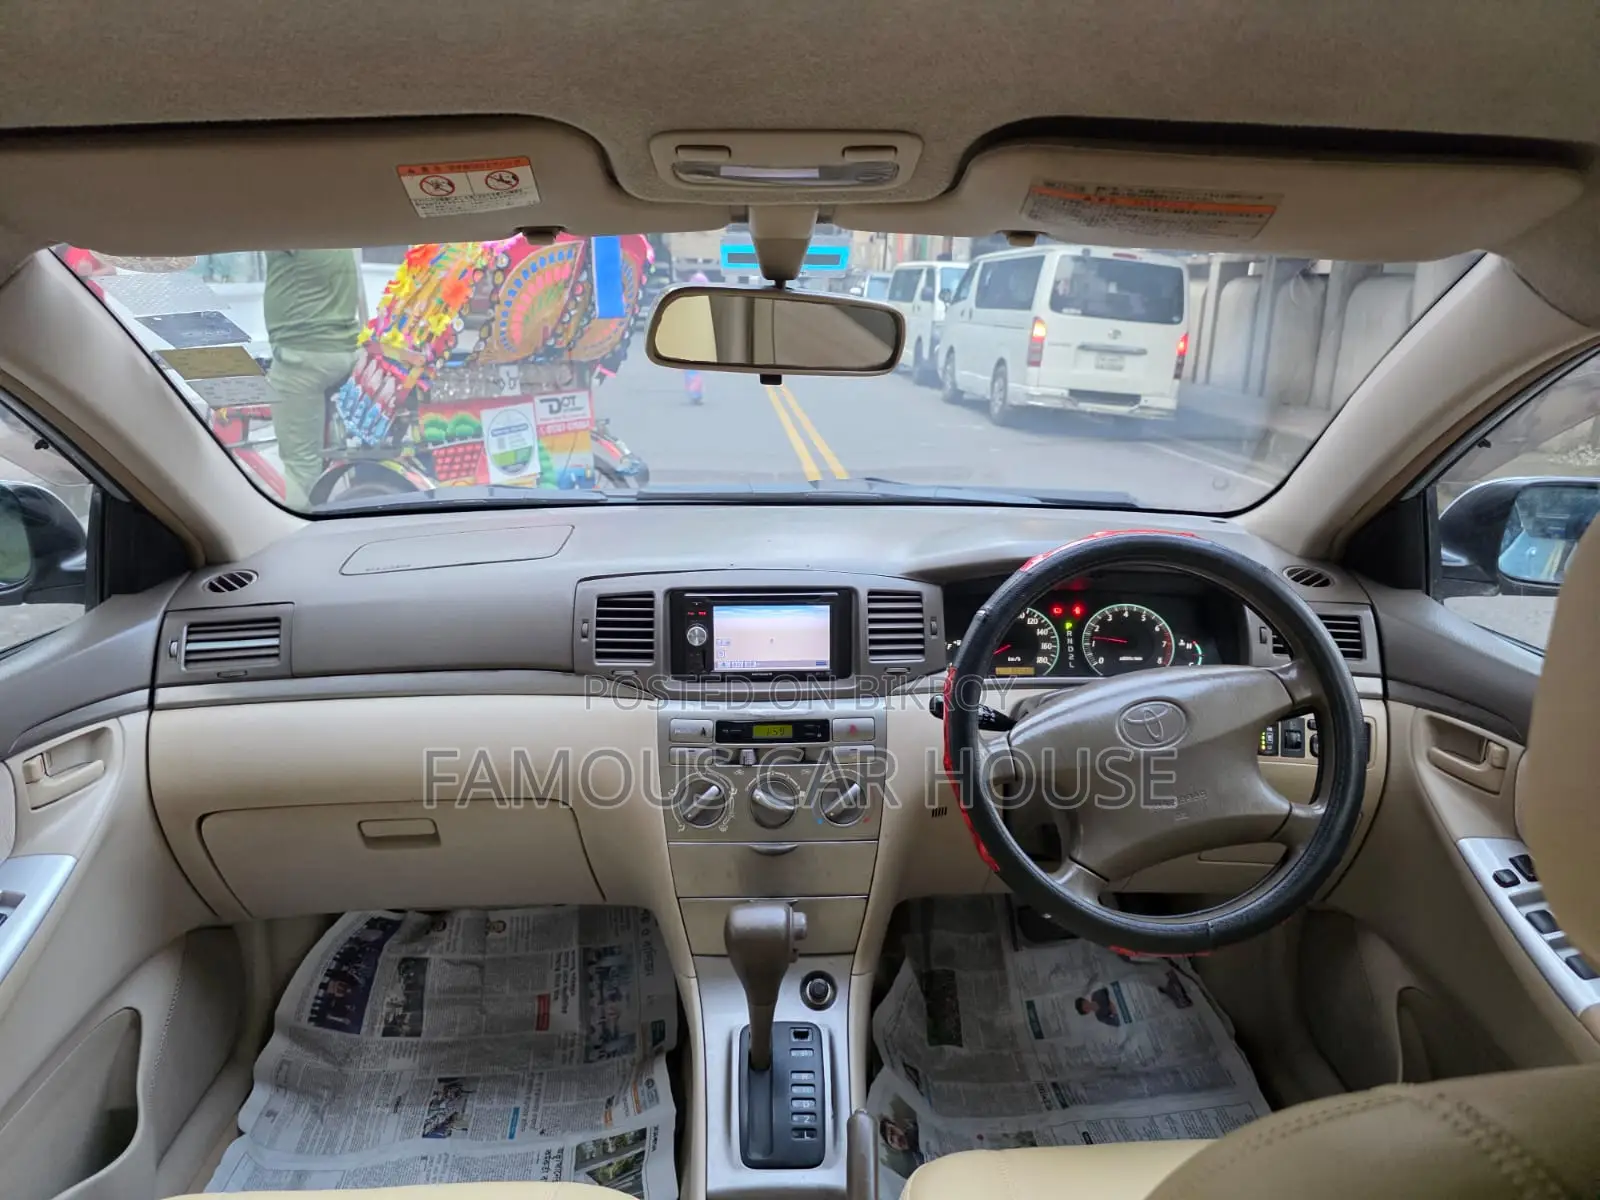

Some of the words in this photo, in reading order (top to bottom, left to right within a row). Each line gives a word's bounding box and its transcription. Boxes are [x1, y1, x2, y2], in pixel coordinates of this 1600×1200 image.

[1107, 614, 1113, 622] 3
[1141, 614, 1146, 622] 5
[1154, 624, 1160, 632] 6
[1162, 640, 1167, 648] 7
[1098, 656, 1105, 664] 0
